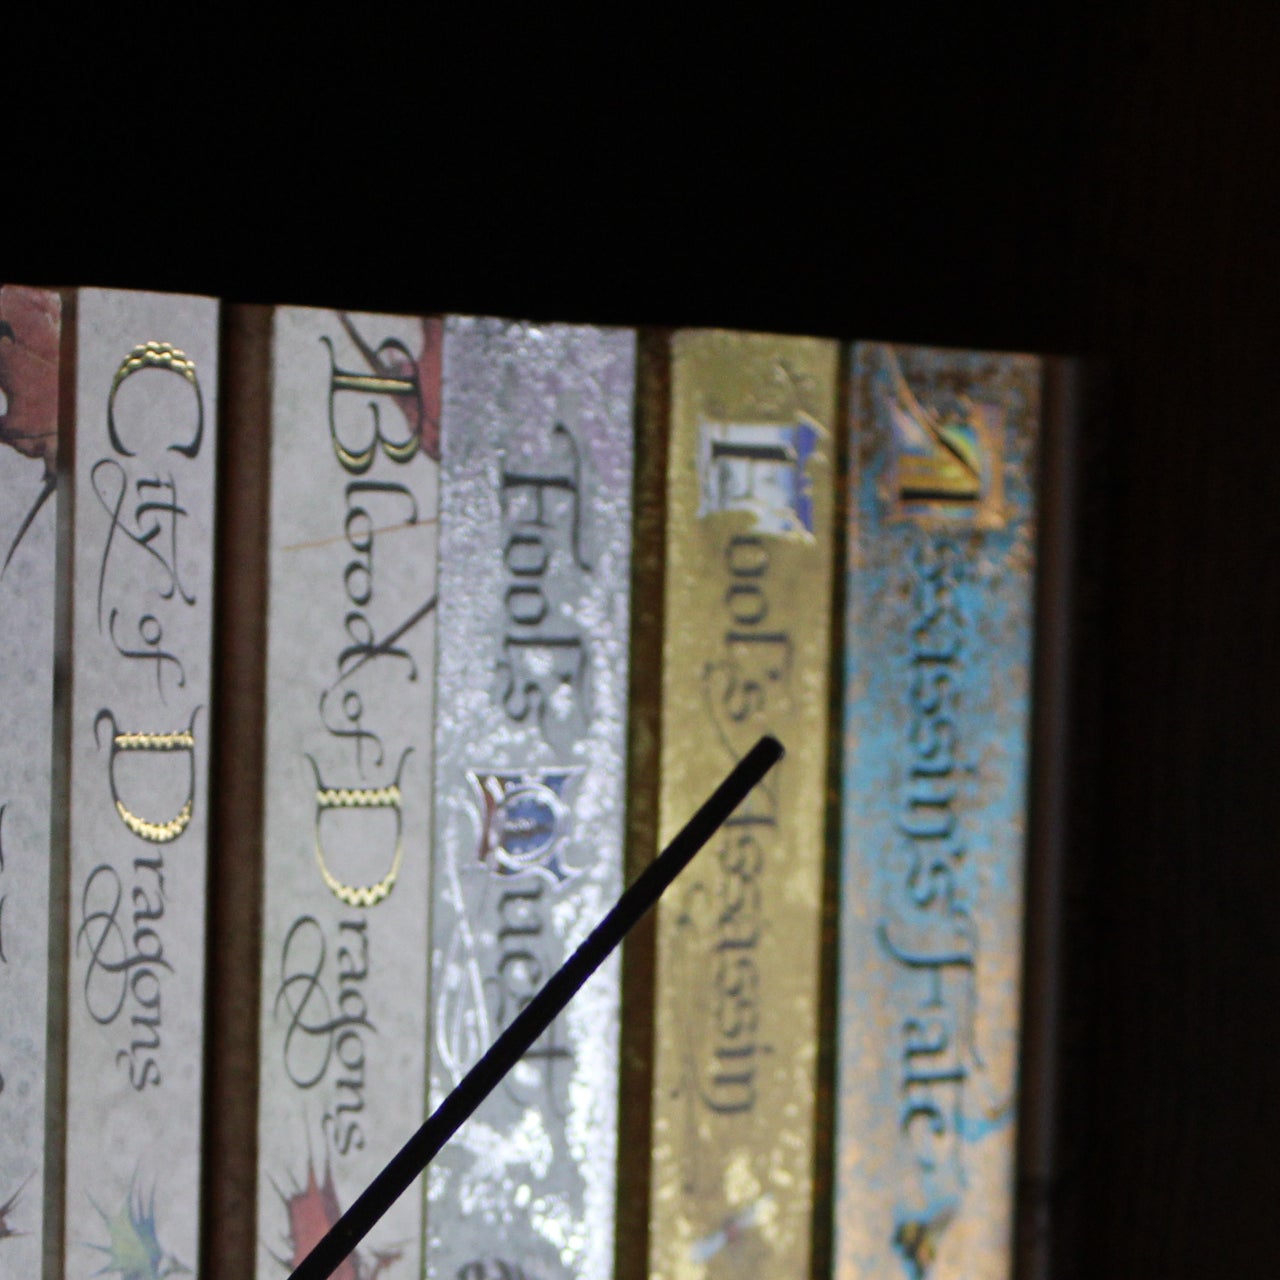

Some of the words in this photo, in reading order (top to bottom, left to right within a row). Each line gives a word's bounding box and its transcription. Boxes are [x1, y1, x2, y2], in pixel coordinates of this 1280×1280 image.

[90, 341, 204, 634] City
[319, 336, 421, 682] Blood
[110, 606, 186, 706] of
[319, 690, 384, 780] of
[76, 705, 204, 1093] Dragons
[274, 746, 416, 1156] Dragons
